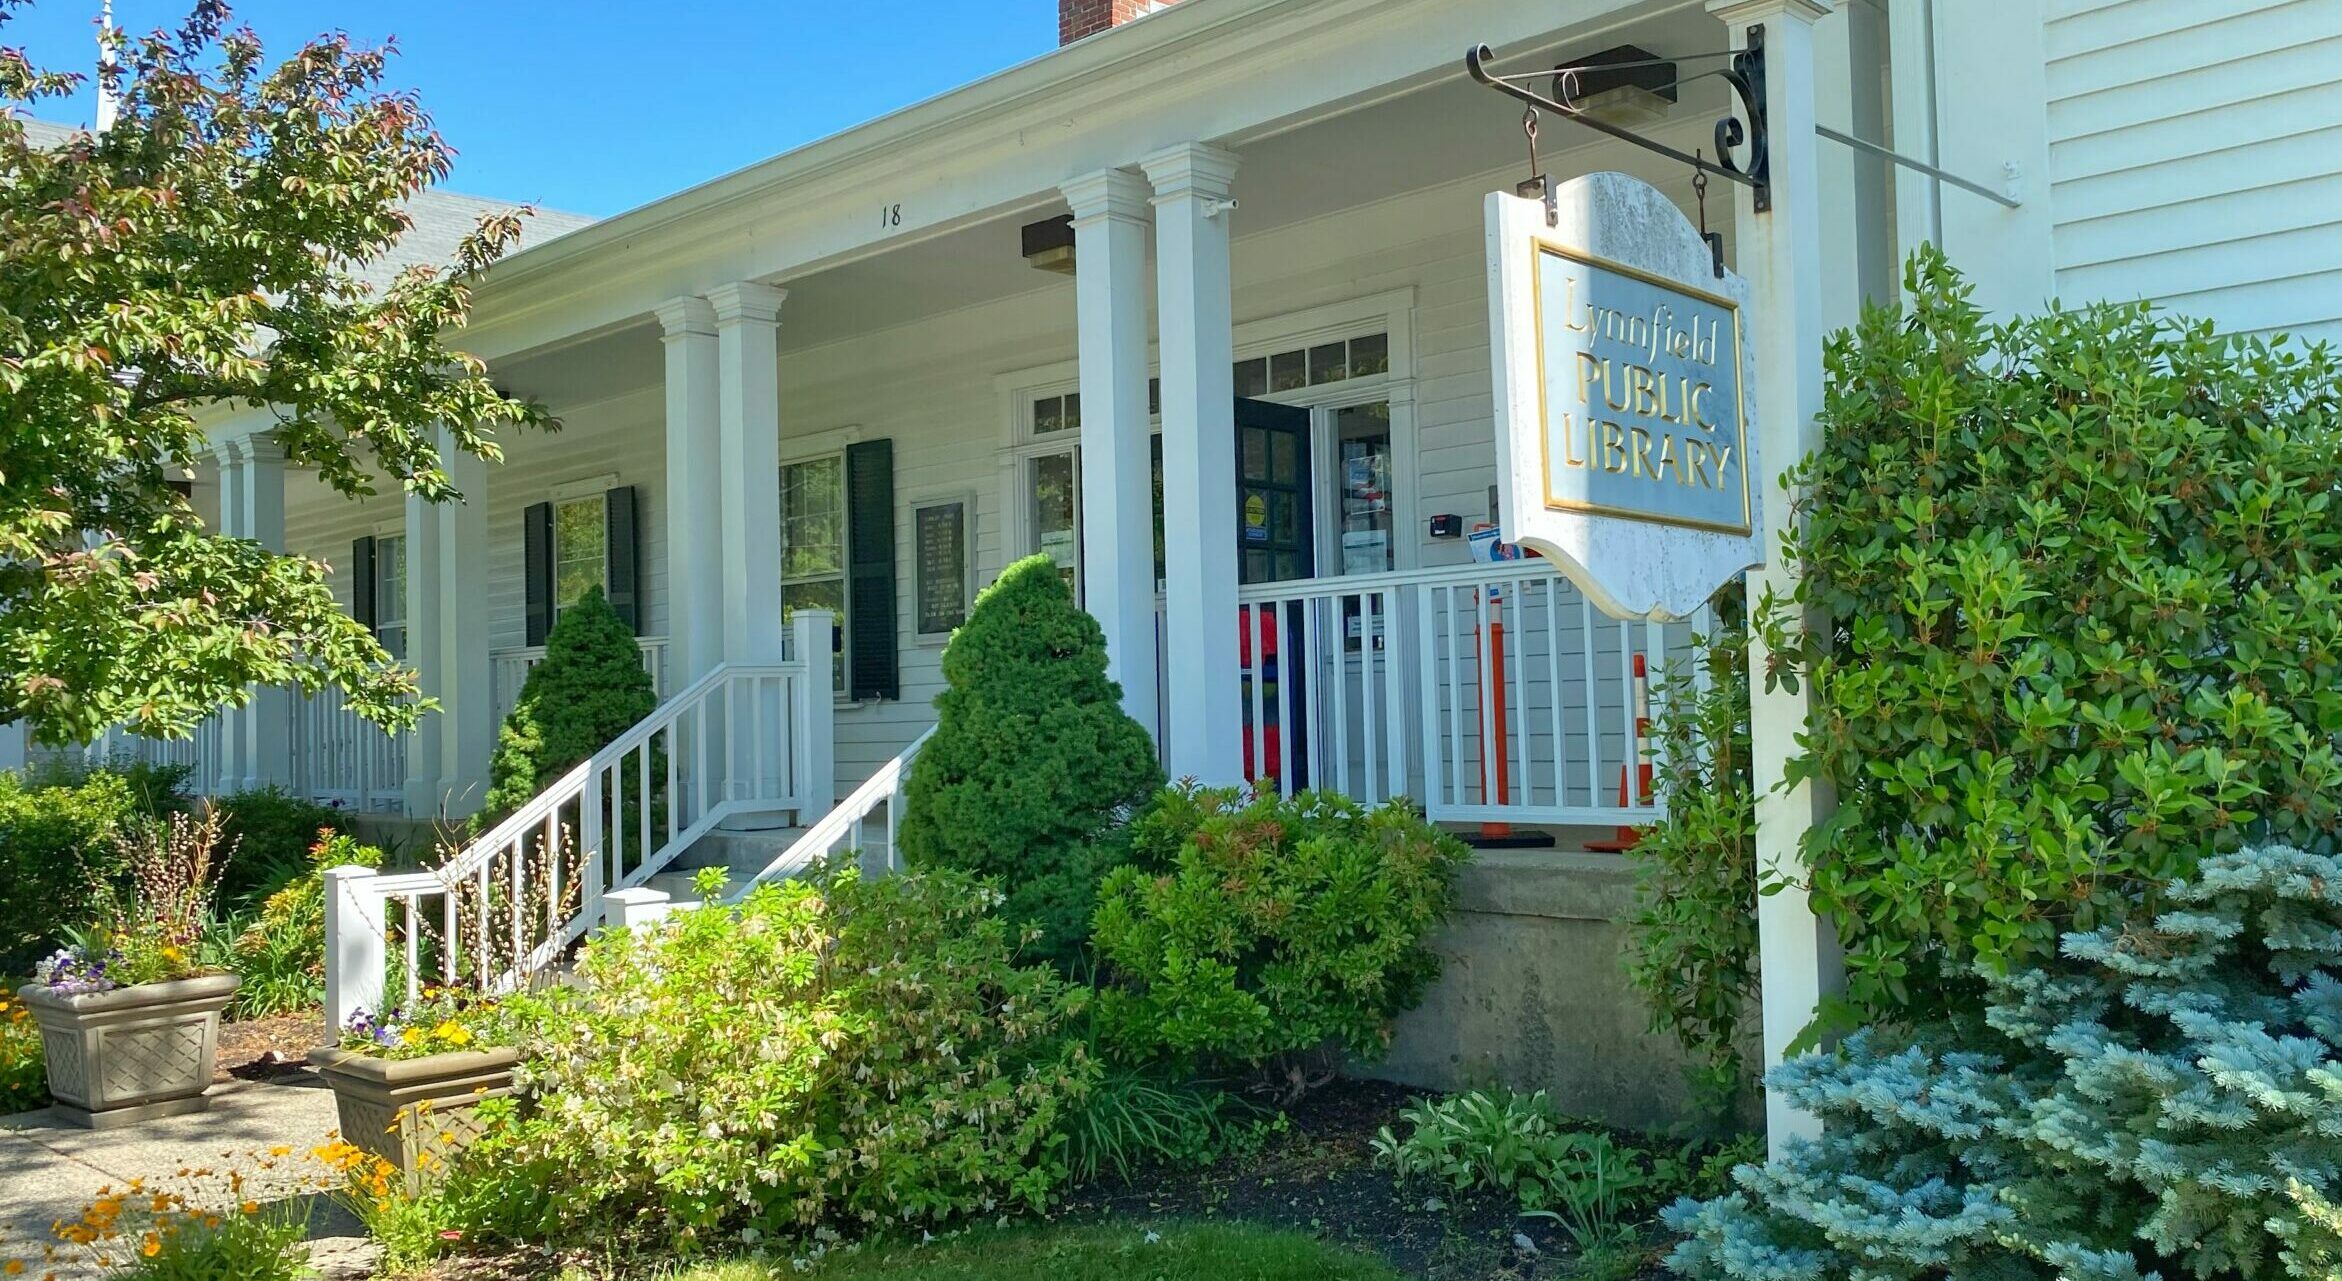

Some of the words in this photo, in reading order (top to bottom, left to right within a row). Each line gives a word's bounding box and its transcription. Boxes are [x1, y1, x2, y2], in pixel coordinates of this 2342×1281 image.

[882, 203, 901, 229] 18
[1564, 278, 1717, 366] Lynnfield
[1576, 351, 1716, 433] PUBLIC
[1563, 413, 1731, 491] LIBRARY
